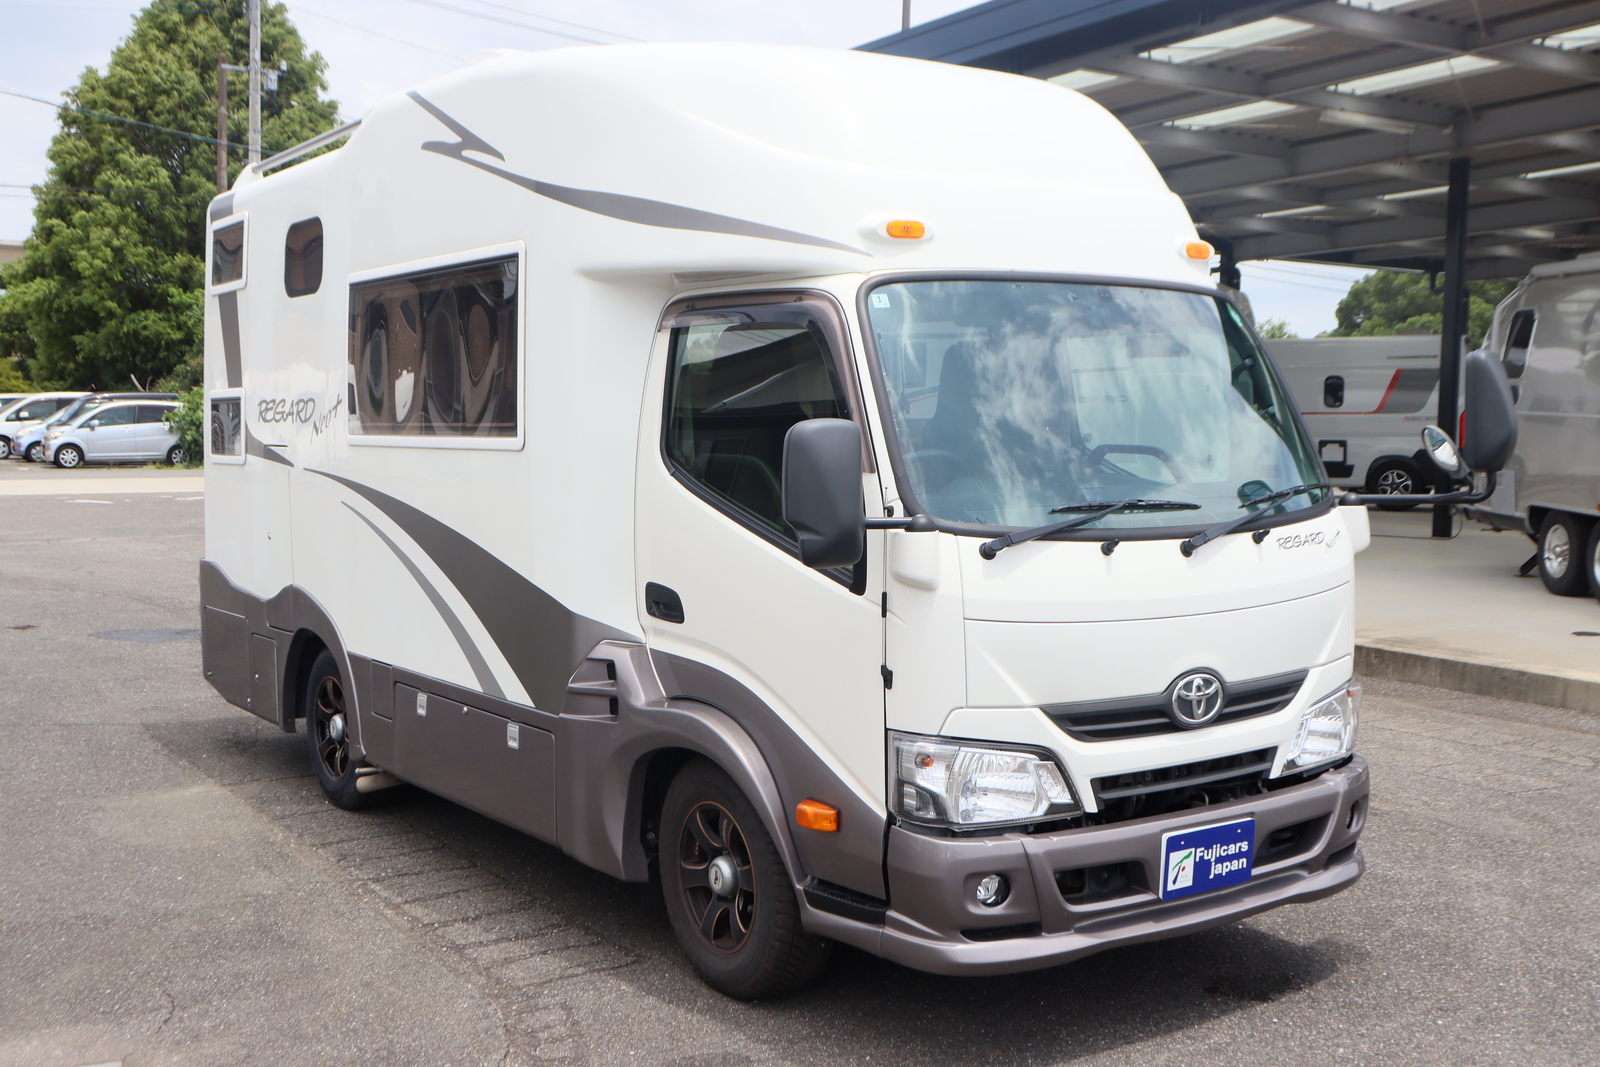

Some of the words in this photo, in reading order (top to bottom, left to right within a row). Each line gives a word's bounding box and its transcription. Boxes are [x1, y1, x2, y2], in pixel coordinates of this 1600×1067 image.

[1075, 395, 1128, 404] EFIRO
[257, 398, 315, 424] REGARD
[1276, 531, 1325, 550] REGARD
[1196, 841, 1249, 862] Fujicars
